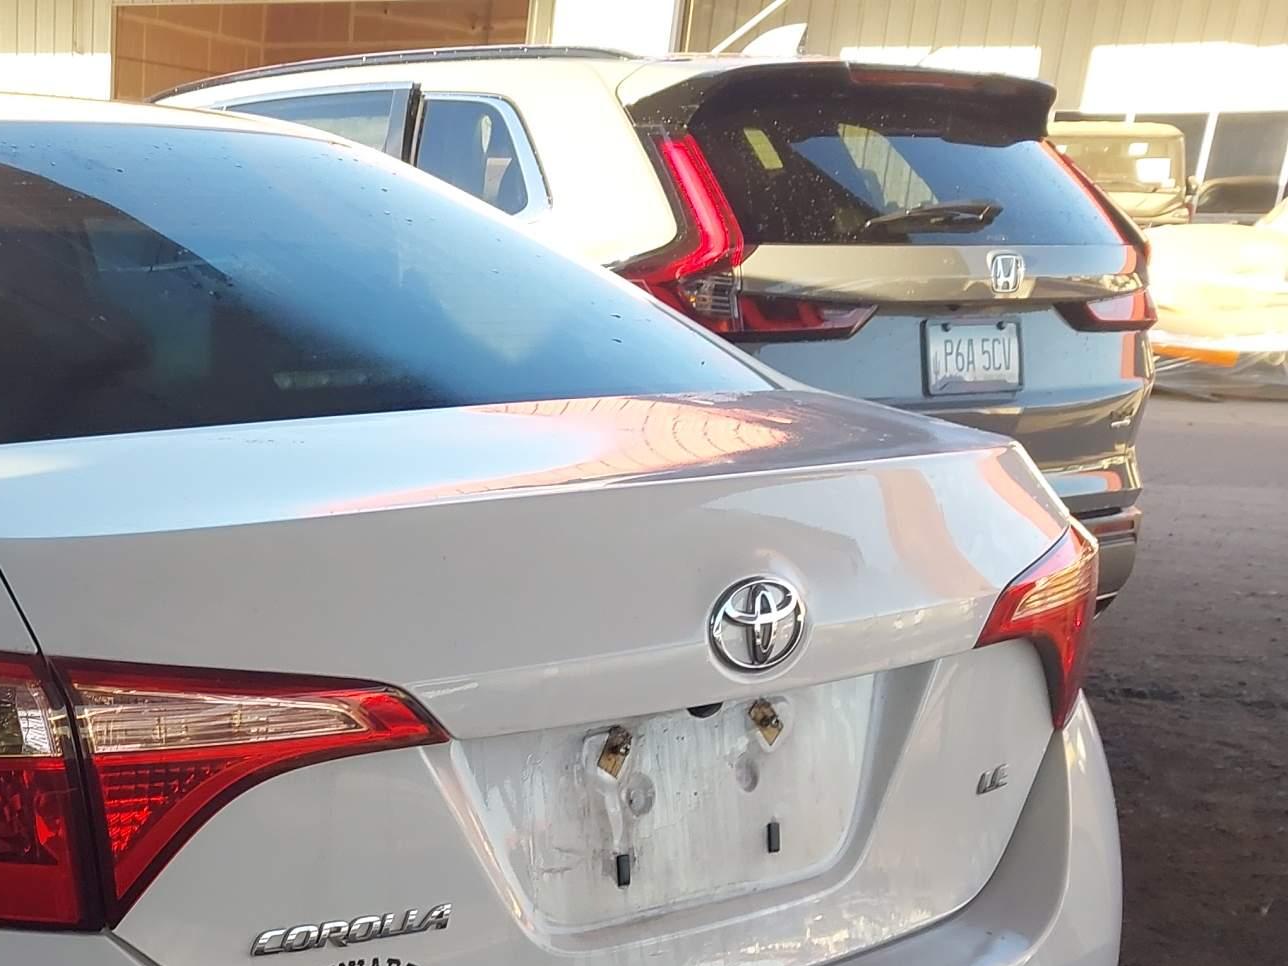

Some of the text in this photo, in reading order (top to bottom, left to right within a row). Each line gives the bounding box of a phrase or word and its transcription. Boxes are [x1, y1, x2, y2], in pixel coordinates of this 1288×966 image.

[944, 337, 1011, 373] P6A 5CV
[976, 754, 1008, 795] LE
[250, 903, 452, 957] COROLLA
